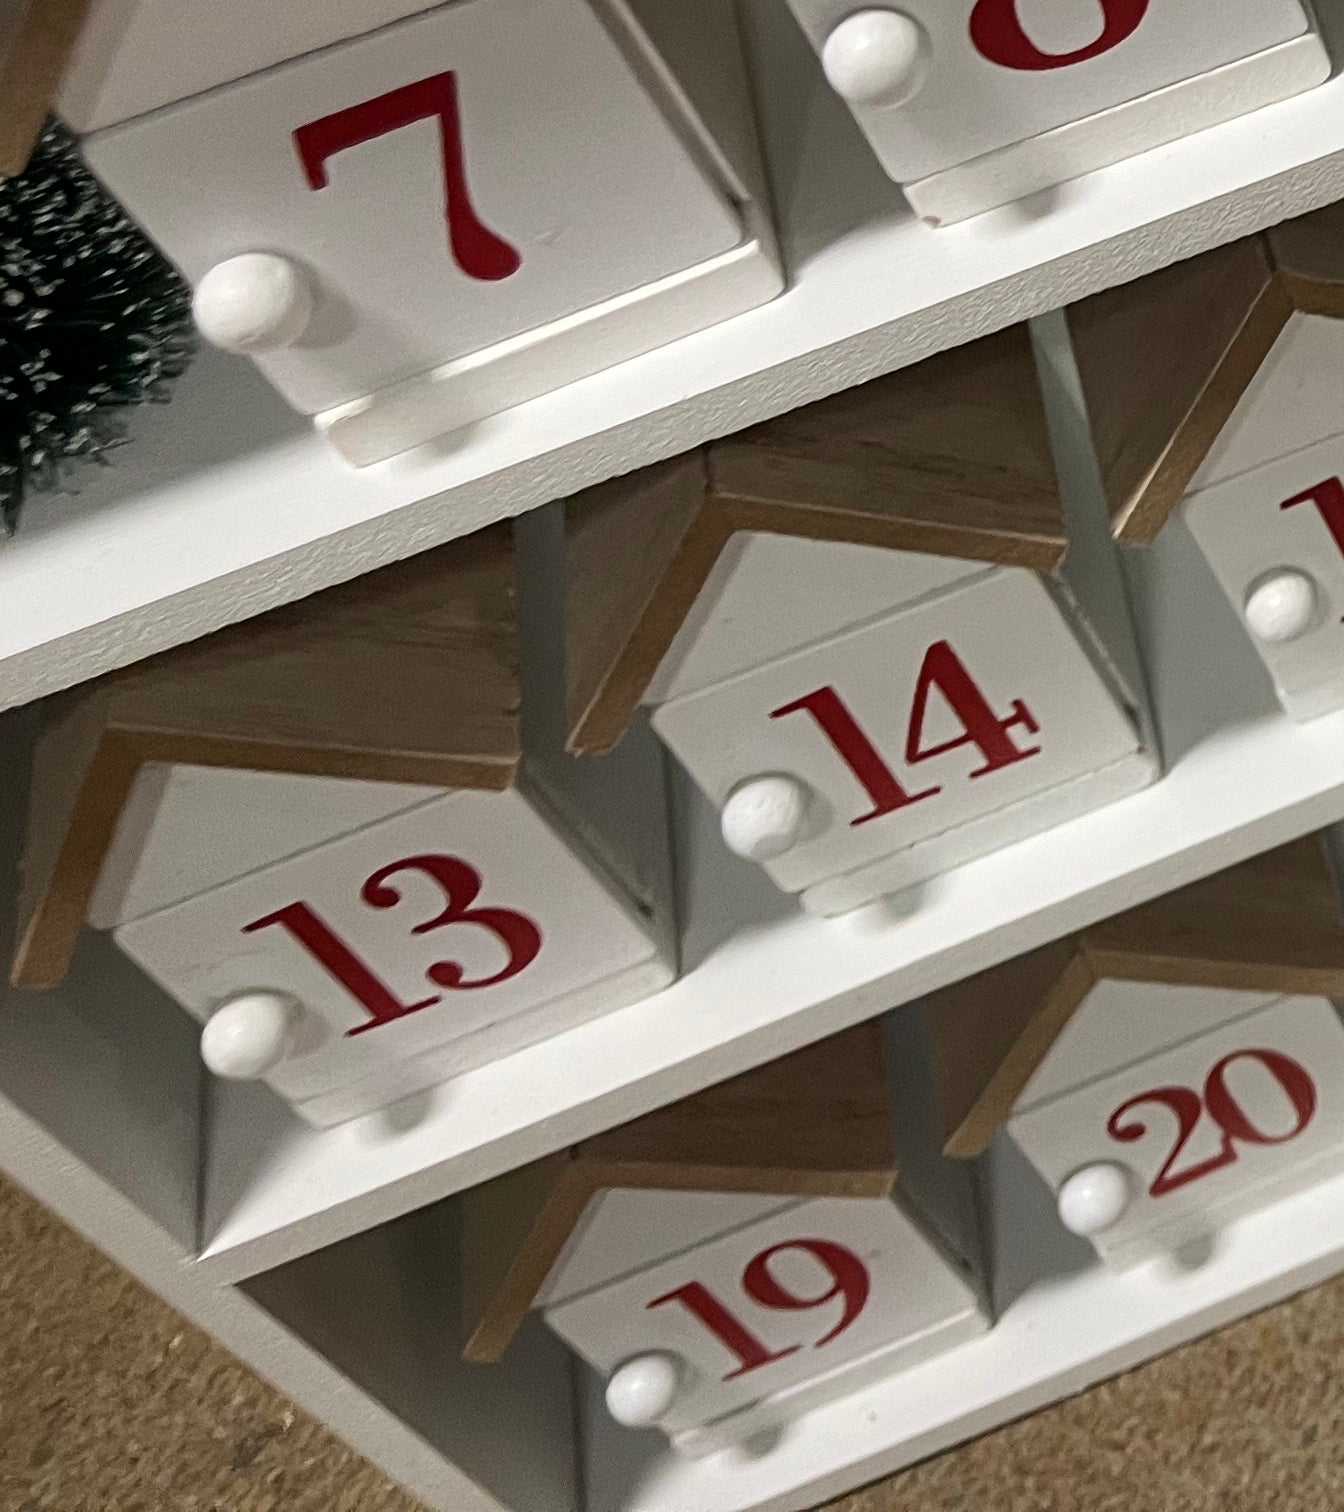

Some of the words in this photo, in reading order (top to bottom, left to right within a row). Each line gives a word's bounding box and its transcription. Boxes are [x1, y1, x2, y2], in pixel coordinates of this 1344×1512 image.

[293, 70, 521, 281] 7
[772, 640, 1040, 826] 14
[246, 854, 542, 1036] 13
[1108, 1050, 1316, 1197] 20
[646, 1240, 870, 1381] 19
